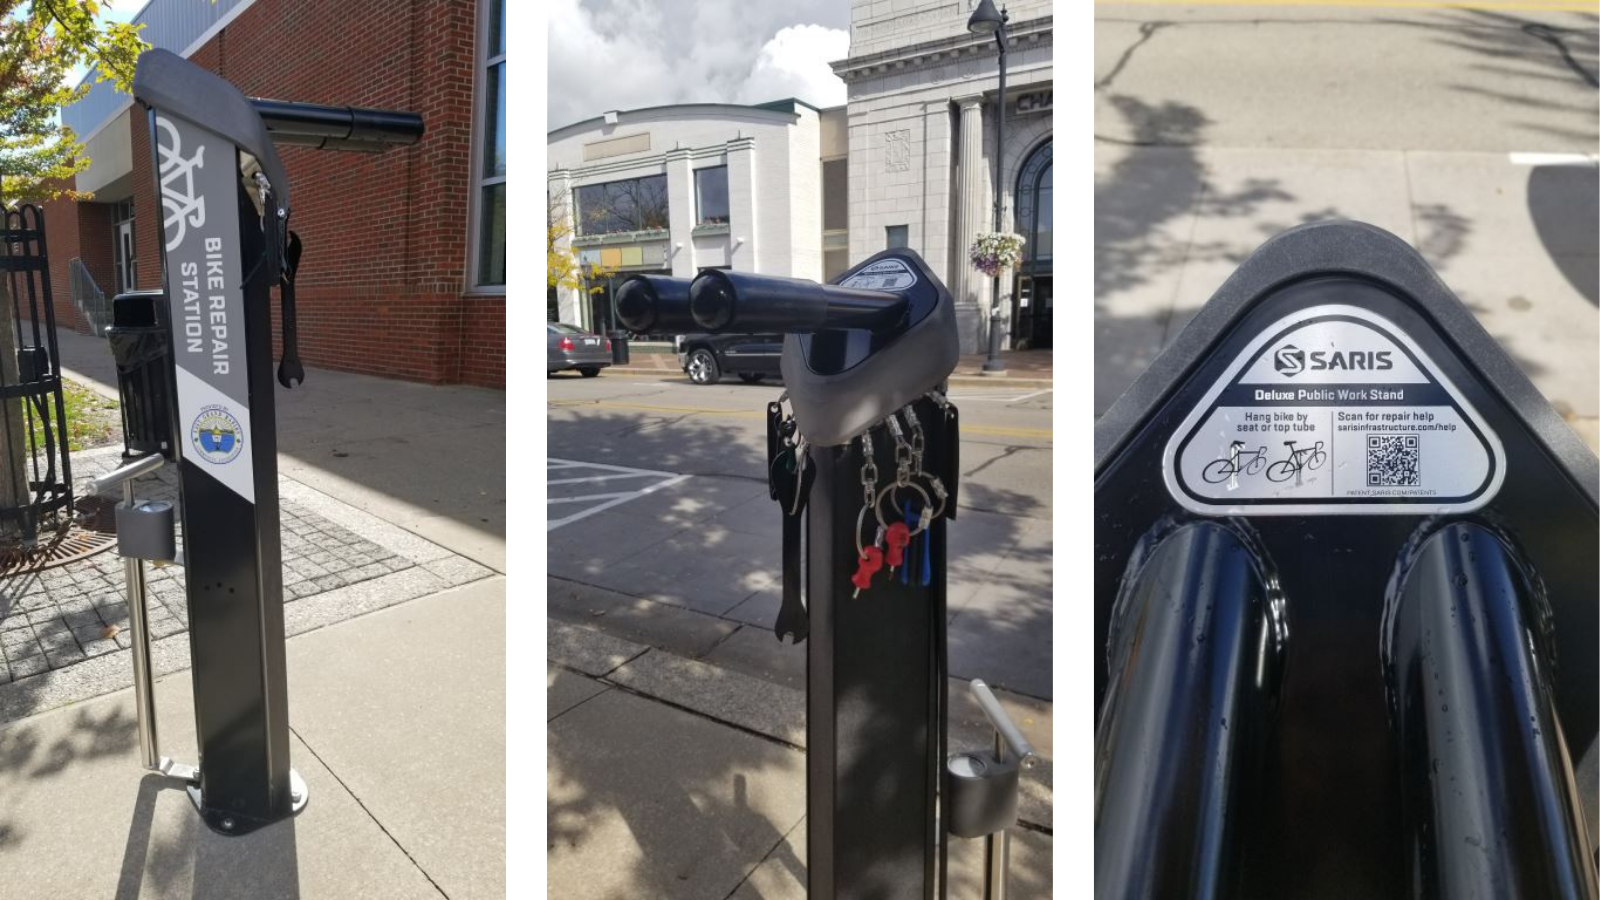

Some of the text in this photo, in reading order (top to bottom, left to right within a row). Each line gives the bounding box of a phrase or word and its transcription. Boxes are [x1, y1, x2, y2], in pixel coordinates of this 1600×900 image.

[181, 262, 203, 353] STATION
[205, 237, 230, 375] BIKE REPAIR
[1310, 351, 1394, 371] SARIS
[1255, 389, 1404, 401] Deluxe Public Work Stand
[1245, 412, 1308, 423] Hang bike by
[1338, 411, 1435, 422] Scan for repair help
[1237, 423, 1260, 431] seat
[1274, 424, 1290, 433] top
[1292, 423, 1316, 431] tube
[1337, 423, 1457, 432] sarisinfrastructure.com/help
